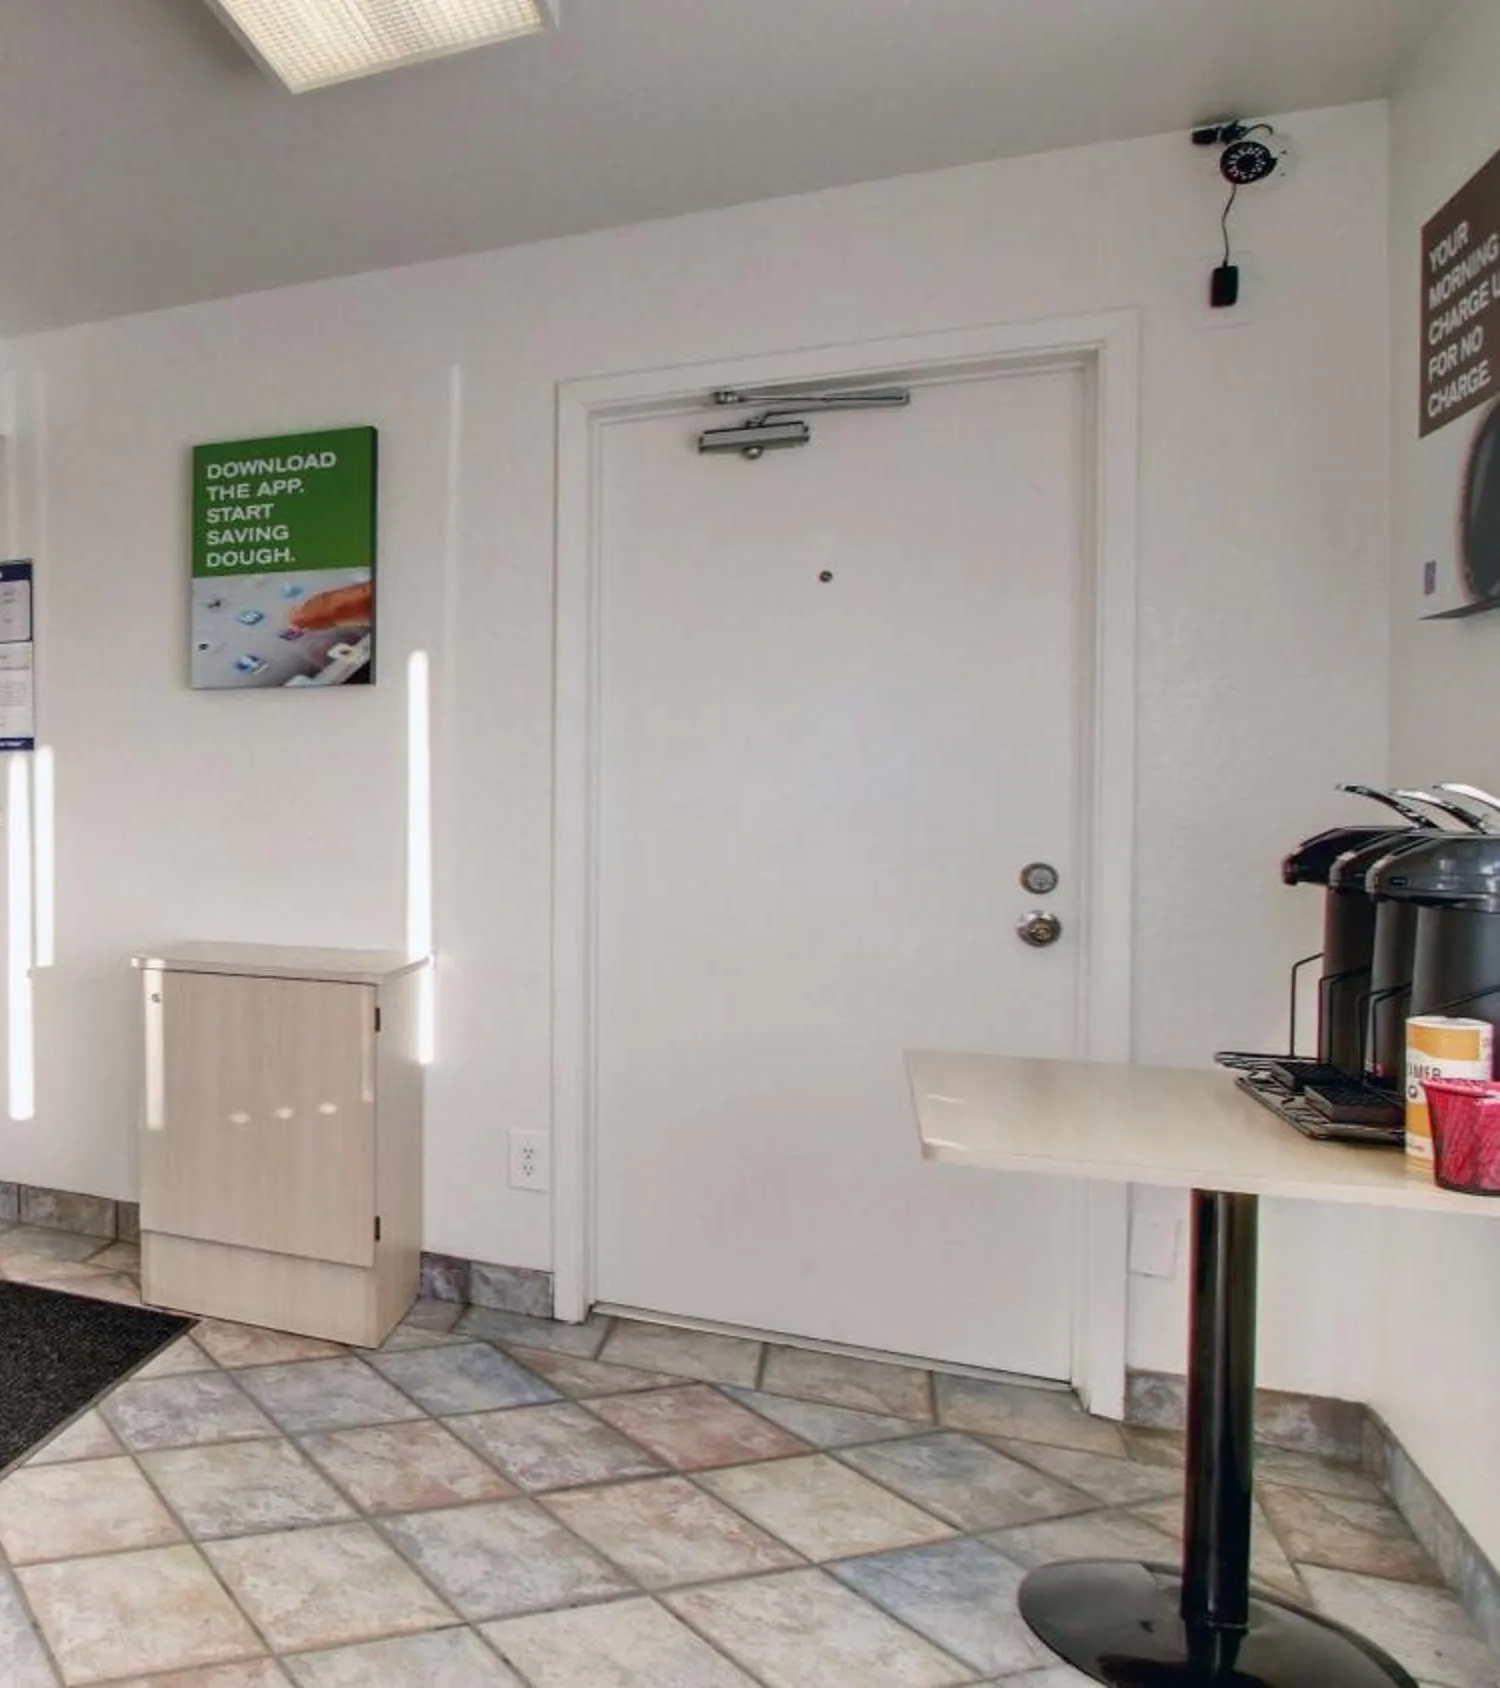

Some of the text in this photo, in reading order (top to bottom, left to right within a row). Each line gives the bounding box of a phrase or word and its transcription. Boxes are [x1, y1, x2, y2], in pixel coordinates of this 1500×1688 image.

[1429, 220, 1469, 272] YOUR
[1429, 233, 1499, 309] MORNING
[1429, 280, 1490, 345] CHARGE
[1428, 325, 1484, 383] FOR NO
[206, 451, 337, 479] DOWNLOAD
[206, 478, 305, 501] THE APP.
[206, 503, 275, 524] START
[206, 525, 290, 546] SAVING
[206, 547, 297, 568] DOUGH.
